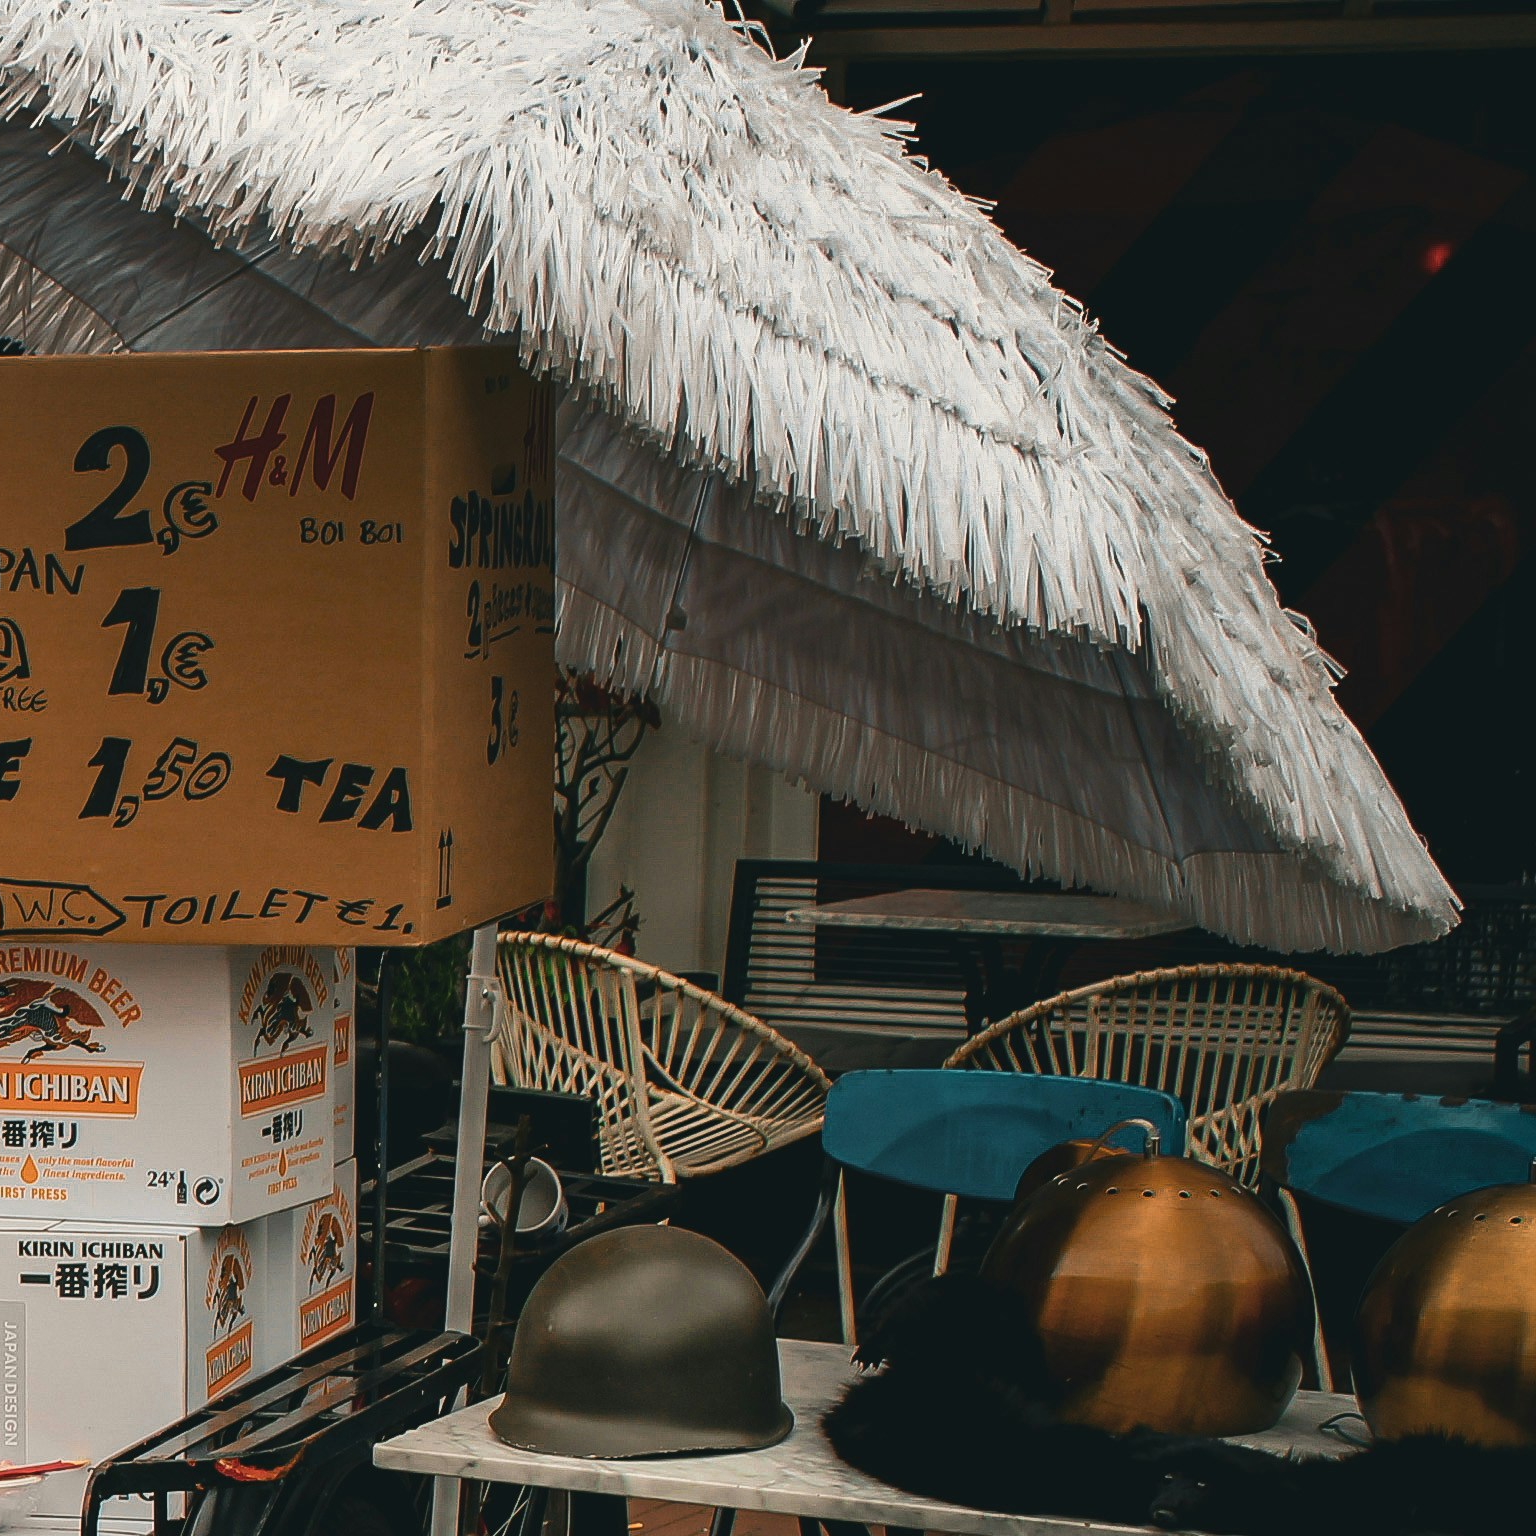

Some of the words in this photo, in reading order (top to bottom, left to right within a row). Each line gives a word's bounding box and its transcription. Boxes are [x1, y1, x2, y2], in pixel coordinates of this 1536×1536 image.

[213, 392, 374, 504] H&M
[299, 517, 344, 544] BOI
[359, 519, 403, 544] BOI
[466, 578, 482, 648] 2
[78, 736, 232, 829] 1,50
[265, 754, 413, 833] TEA
[123, 889, 324, 930] TOILET
[91, 968, 144, 1029] BEER
[239, 966, 259, 1026] KIRIN
[14, 1073, 131, 1105] ICHIBAN
[243, 1065, 276, 1104] KIRIN
[277, 1056, 323, 1096] ICHIBAN
[31, 1187, 68, 1202] PRESS
[18, 1240, 74, 1258] KIRIN
[81, 1241, 164, 1260] ICHIBAN
[4, 1321, 18, 1382] JAPAN
[4, 1383, 18, 1446] DESIGN
